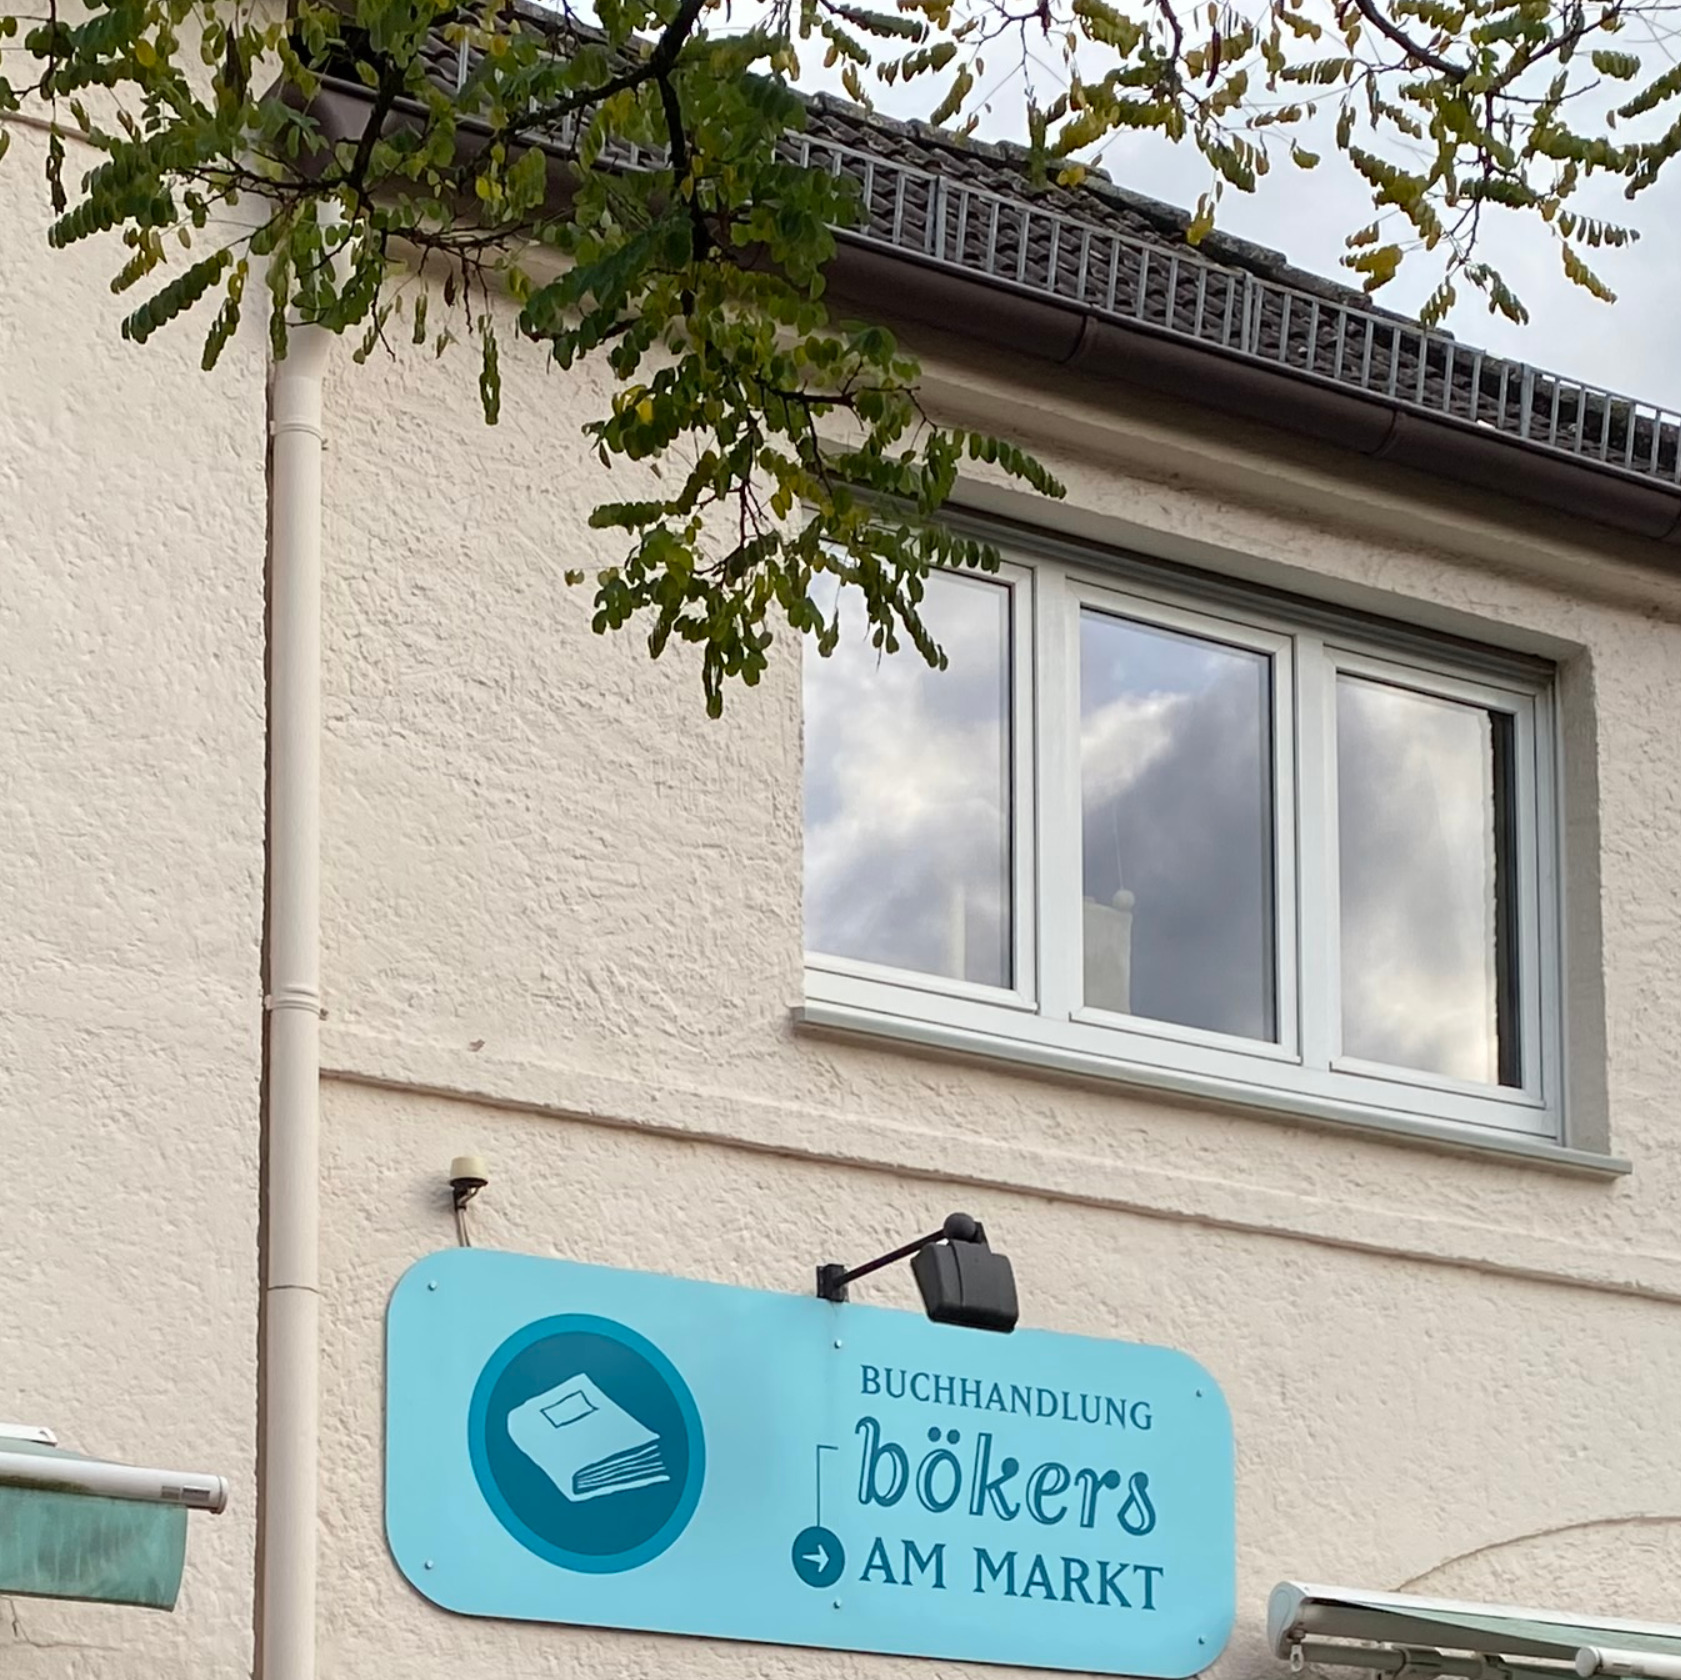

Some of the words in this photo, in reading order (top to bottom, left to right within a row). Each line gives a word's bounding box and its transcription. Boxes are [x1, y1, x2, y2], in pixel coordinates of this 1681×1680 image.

[860, 1363, 1153, 1430] BUCHHANDLUNG
[854, 1415, 1157, 1536] bökers
[859, 1536, 947, 1590] AM
[973, 1546, 1164, 1611] MARKT
